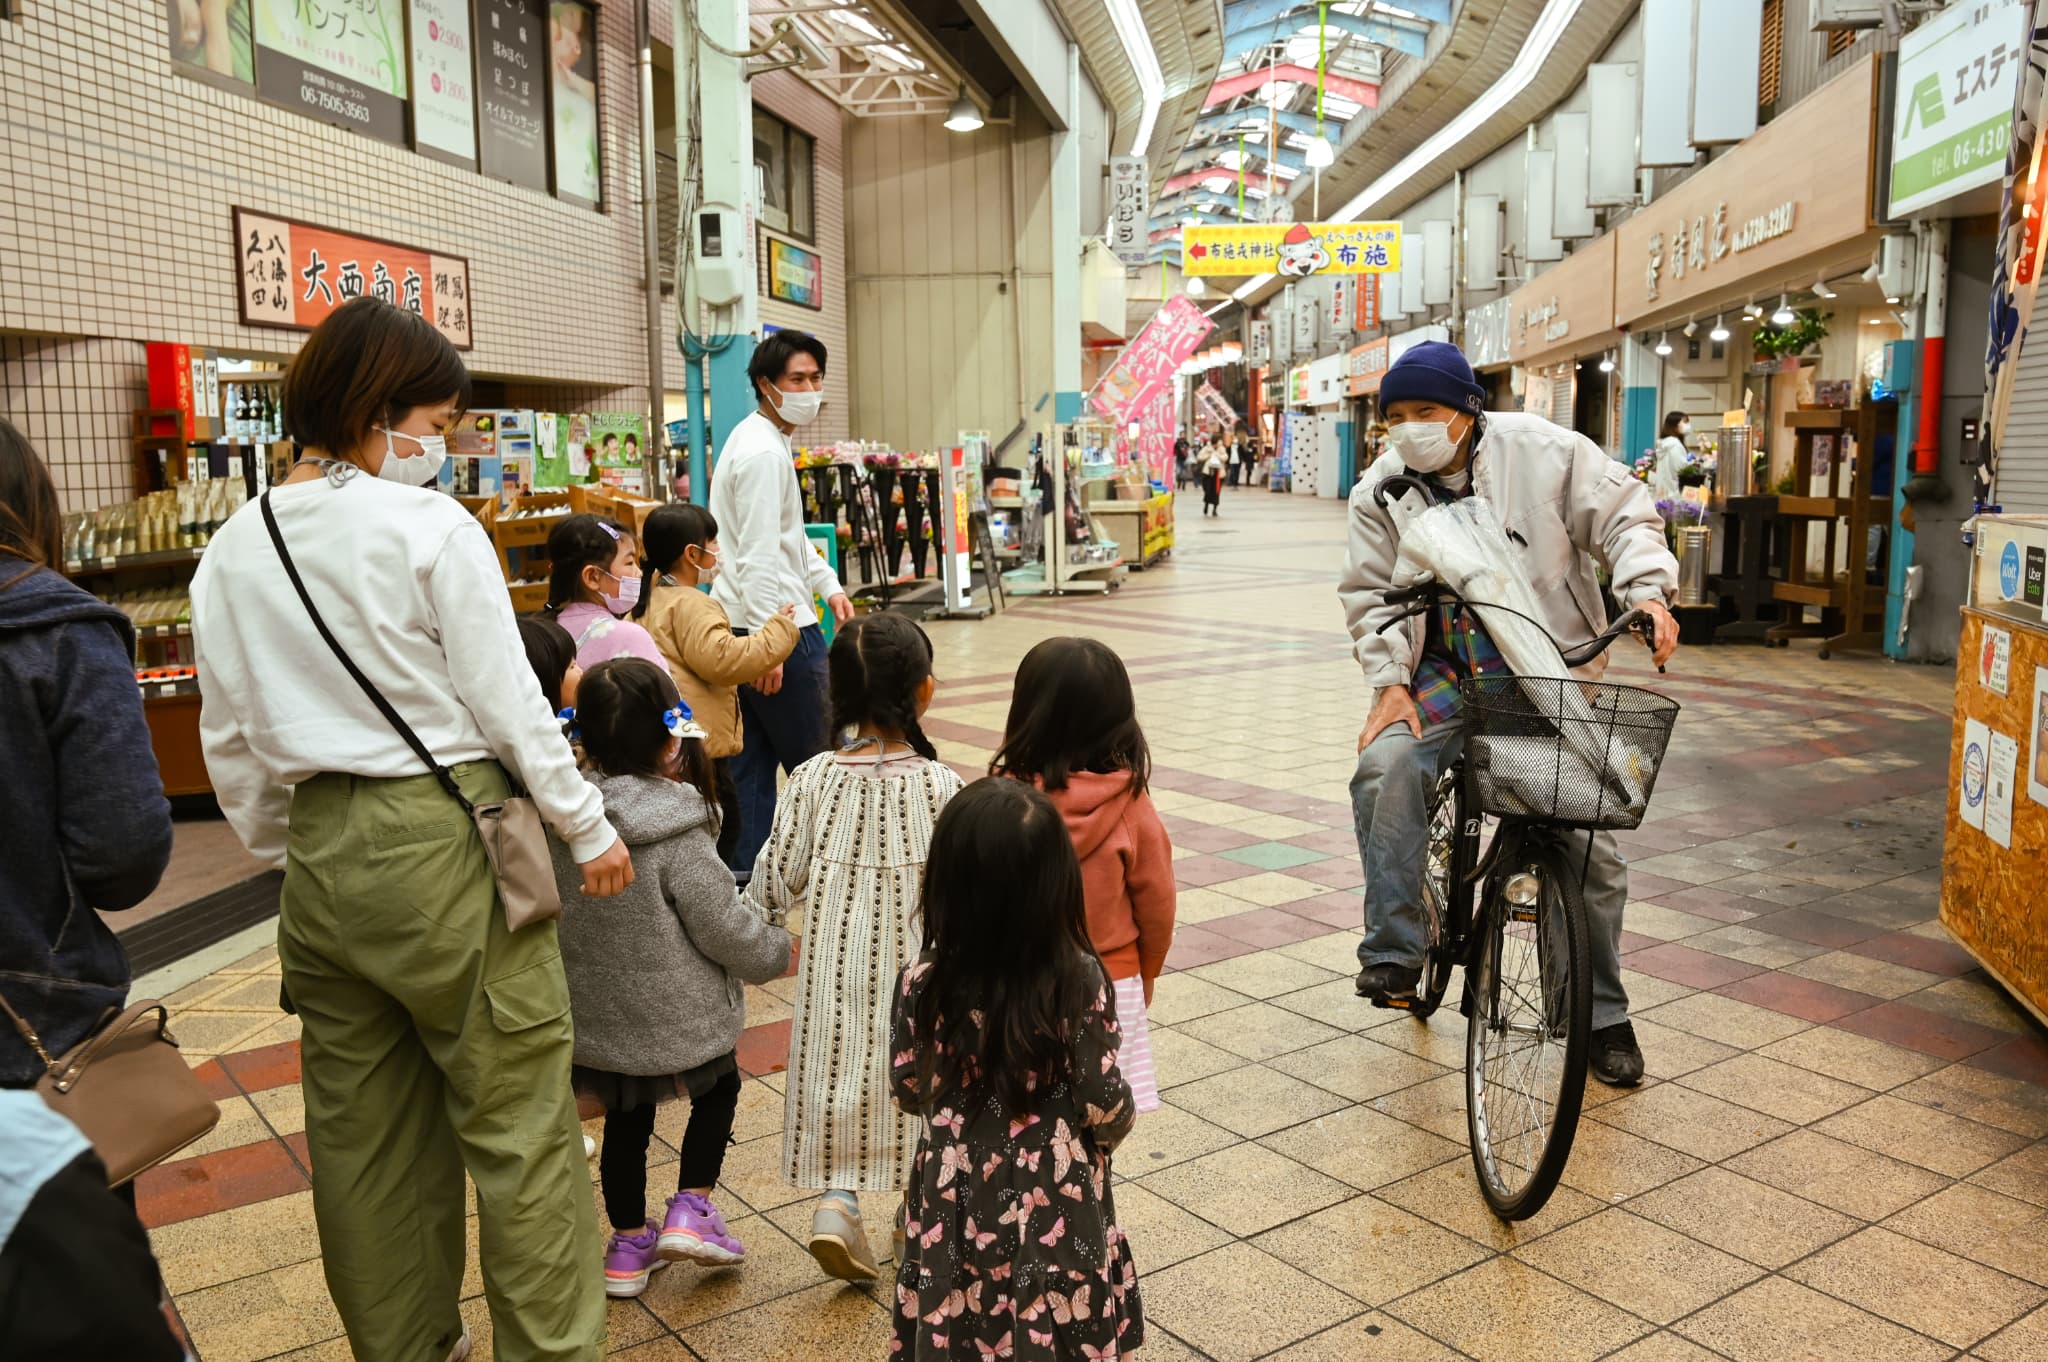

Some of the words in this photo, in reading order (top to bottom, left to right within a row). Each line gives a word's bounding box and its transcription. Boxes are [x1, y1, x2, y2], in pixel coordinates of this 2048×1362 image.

[301, 85, 370, 122] 06-7505-3563
[1115, 183, 1134, 243] いはら
[1336, 244, 1389, 267] 布施
[302, 248, 422, 316] 大西商店
[593, 415, 615, 427] ECC
[2028, 566, 2042, 581] Uber
[2027, 582, 2041, 596] Eats
